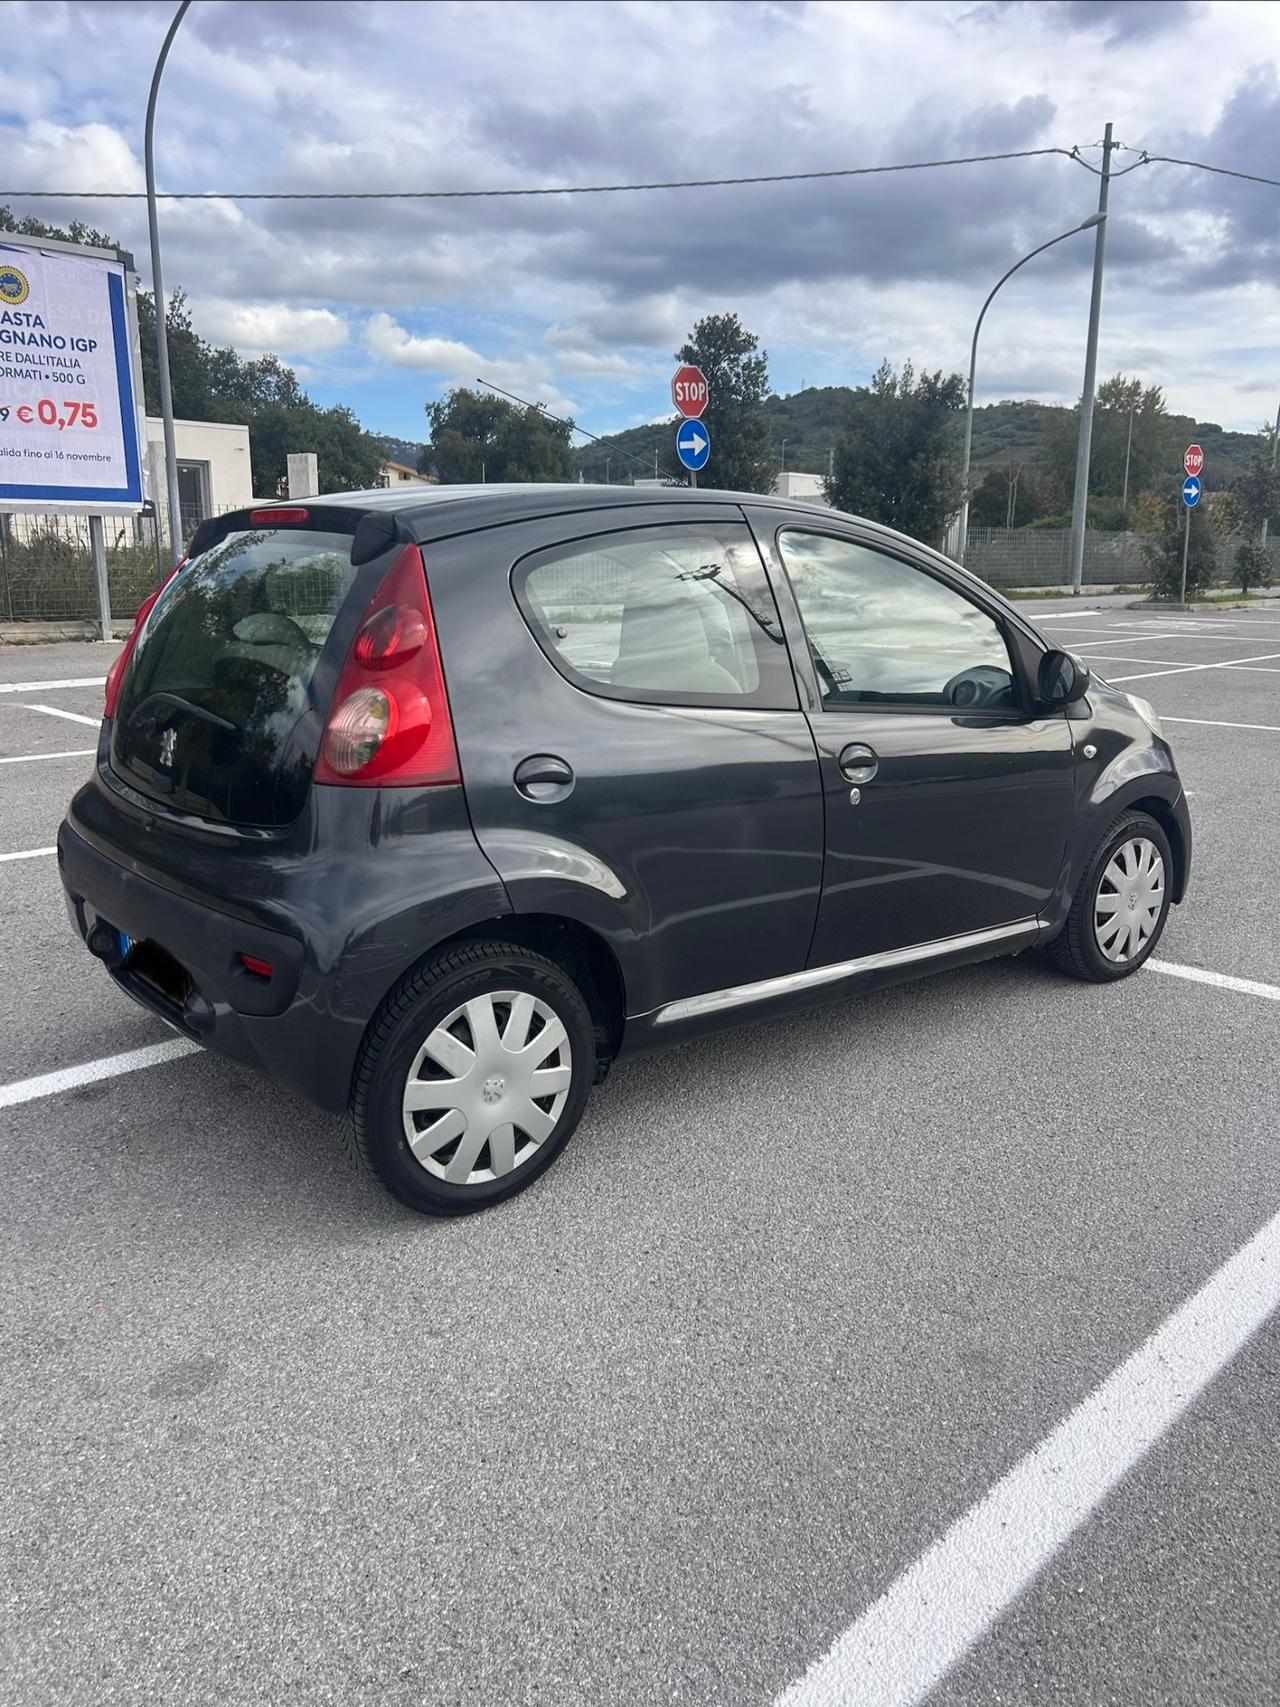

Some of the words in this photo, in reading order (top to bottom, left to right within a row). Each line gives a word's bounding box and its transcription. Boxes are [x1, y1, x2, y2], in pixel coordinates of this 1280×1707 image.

[70, 337, 97, 353] IGP
[15, 352, 81, 369] DALL'ITALIA
[52, 372, 74, 384] 500
[76, 374, 86, 385] G
[675, 382, 706, 401] STOP
[23, 448, 42, 459] fino
[44, 450, 53, 459] al
[55, 450, 64, 460] 16
[66, 452, 112, 462] novembre
[1186, 455, 1201, 466] STOP
